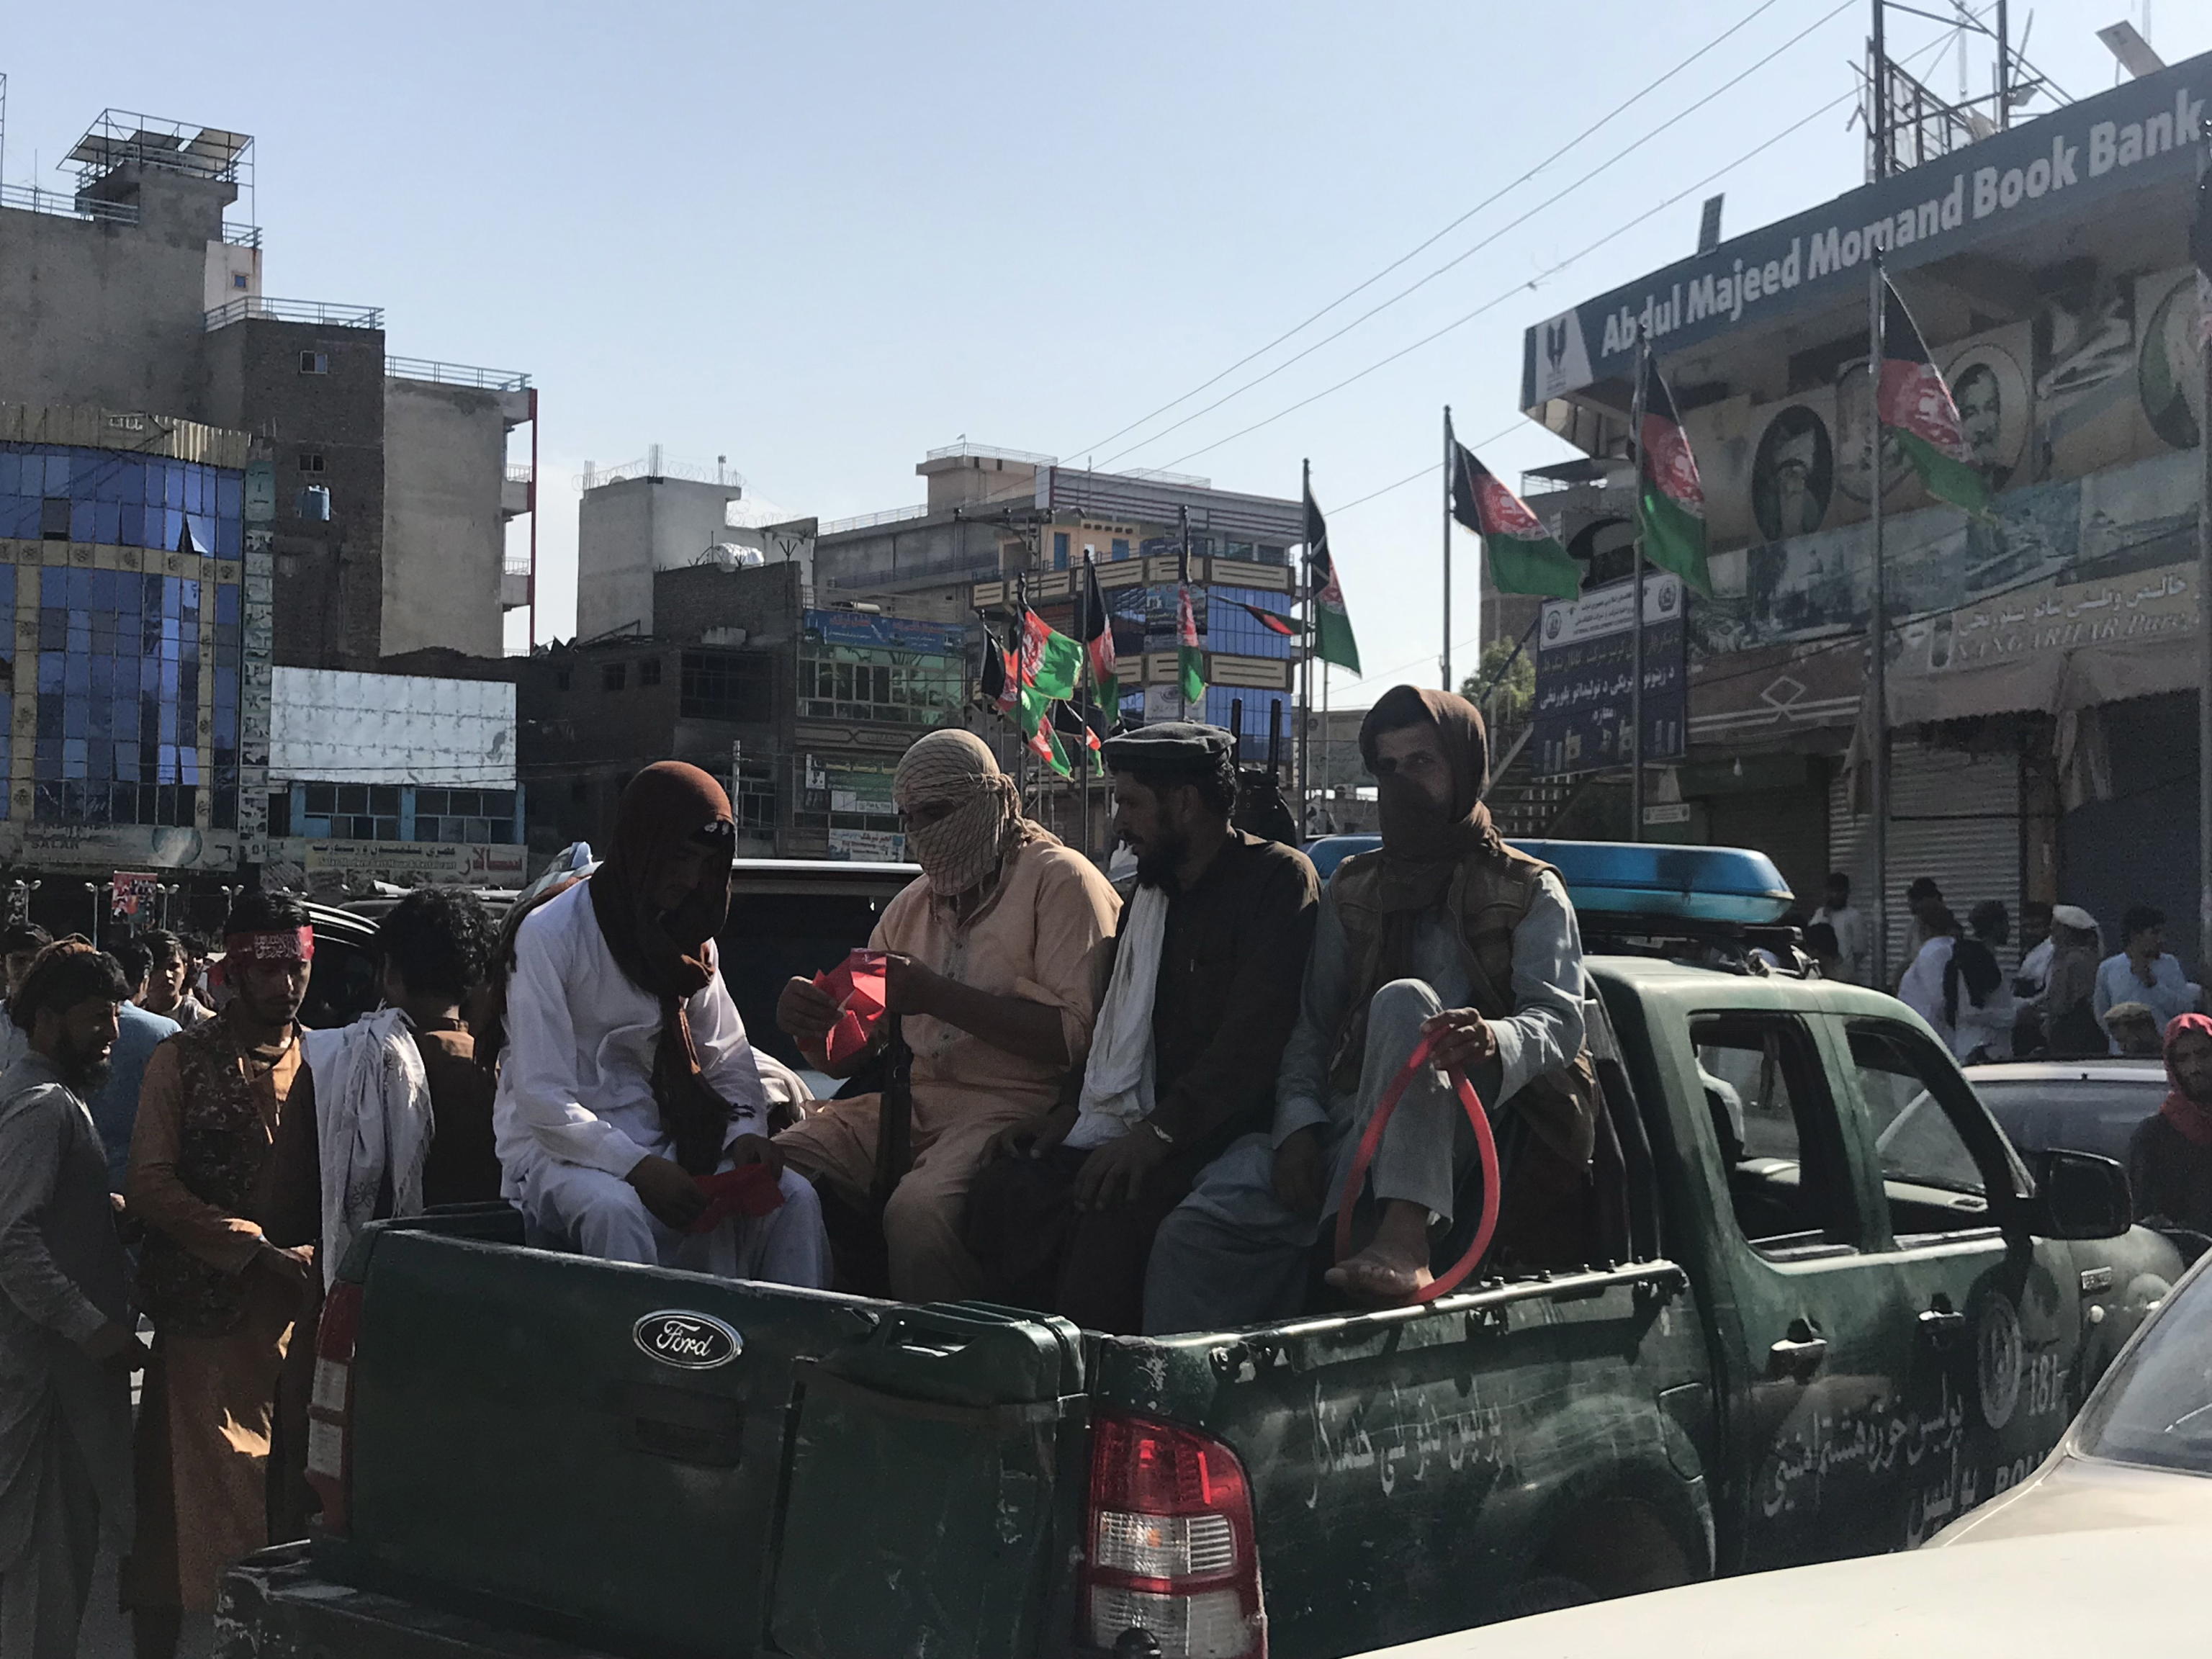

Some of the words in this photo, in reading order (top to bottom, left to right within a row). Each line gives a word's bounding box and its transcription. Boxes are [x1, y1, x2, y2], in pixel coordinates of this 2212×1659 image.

[1601, 284, 1681, 357] Abdul
[1686, 238, 1801, 321] Majeed
[1808, 174, 1965, 280] Momand
[1972, 135, 2080, 219] Book
[2087, 88, 2207, 178] Bank
[656, 1320, 714, 1357] Ford
